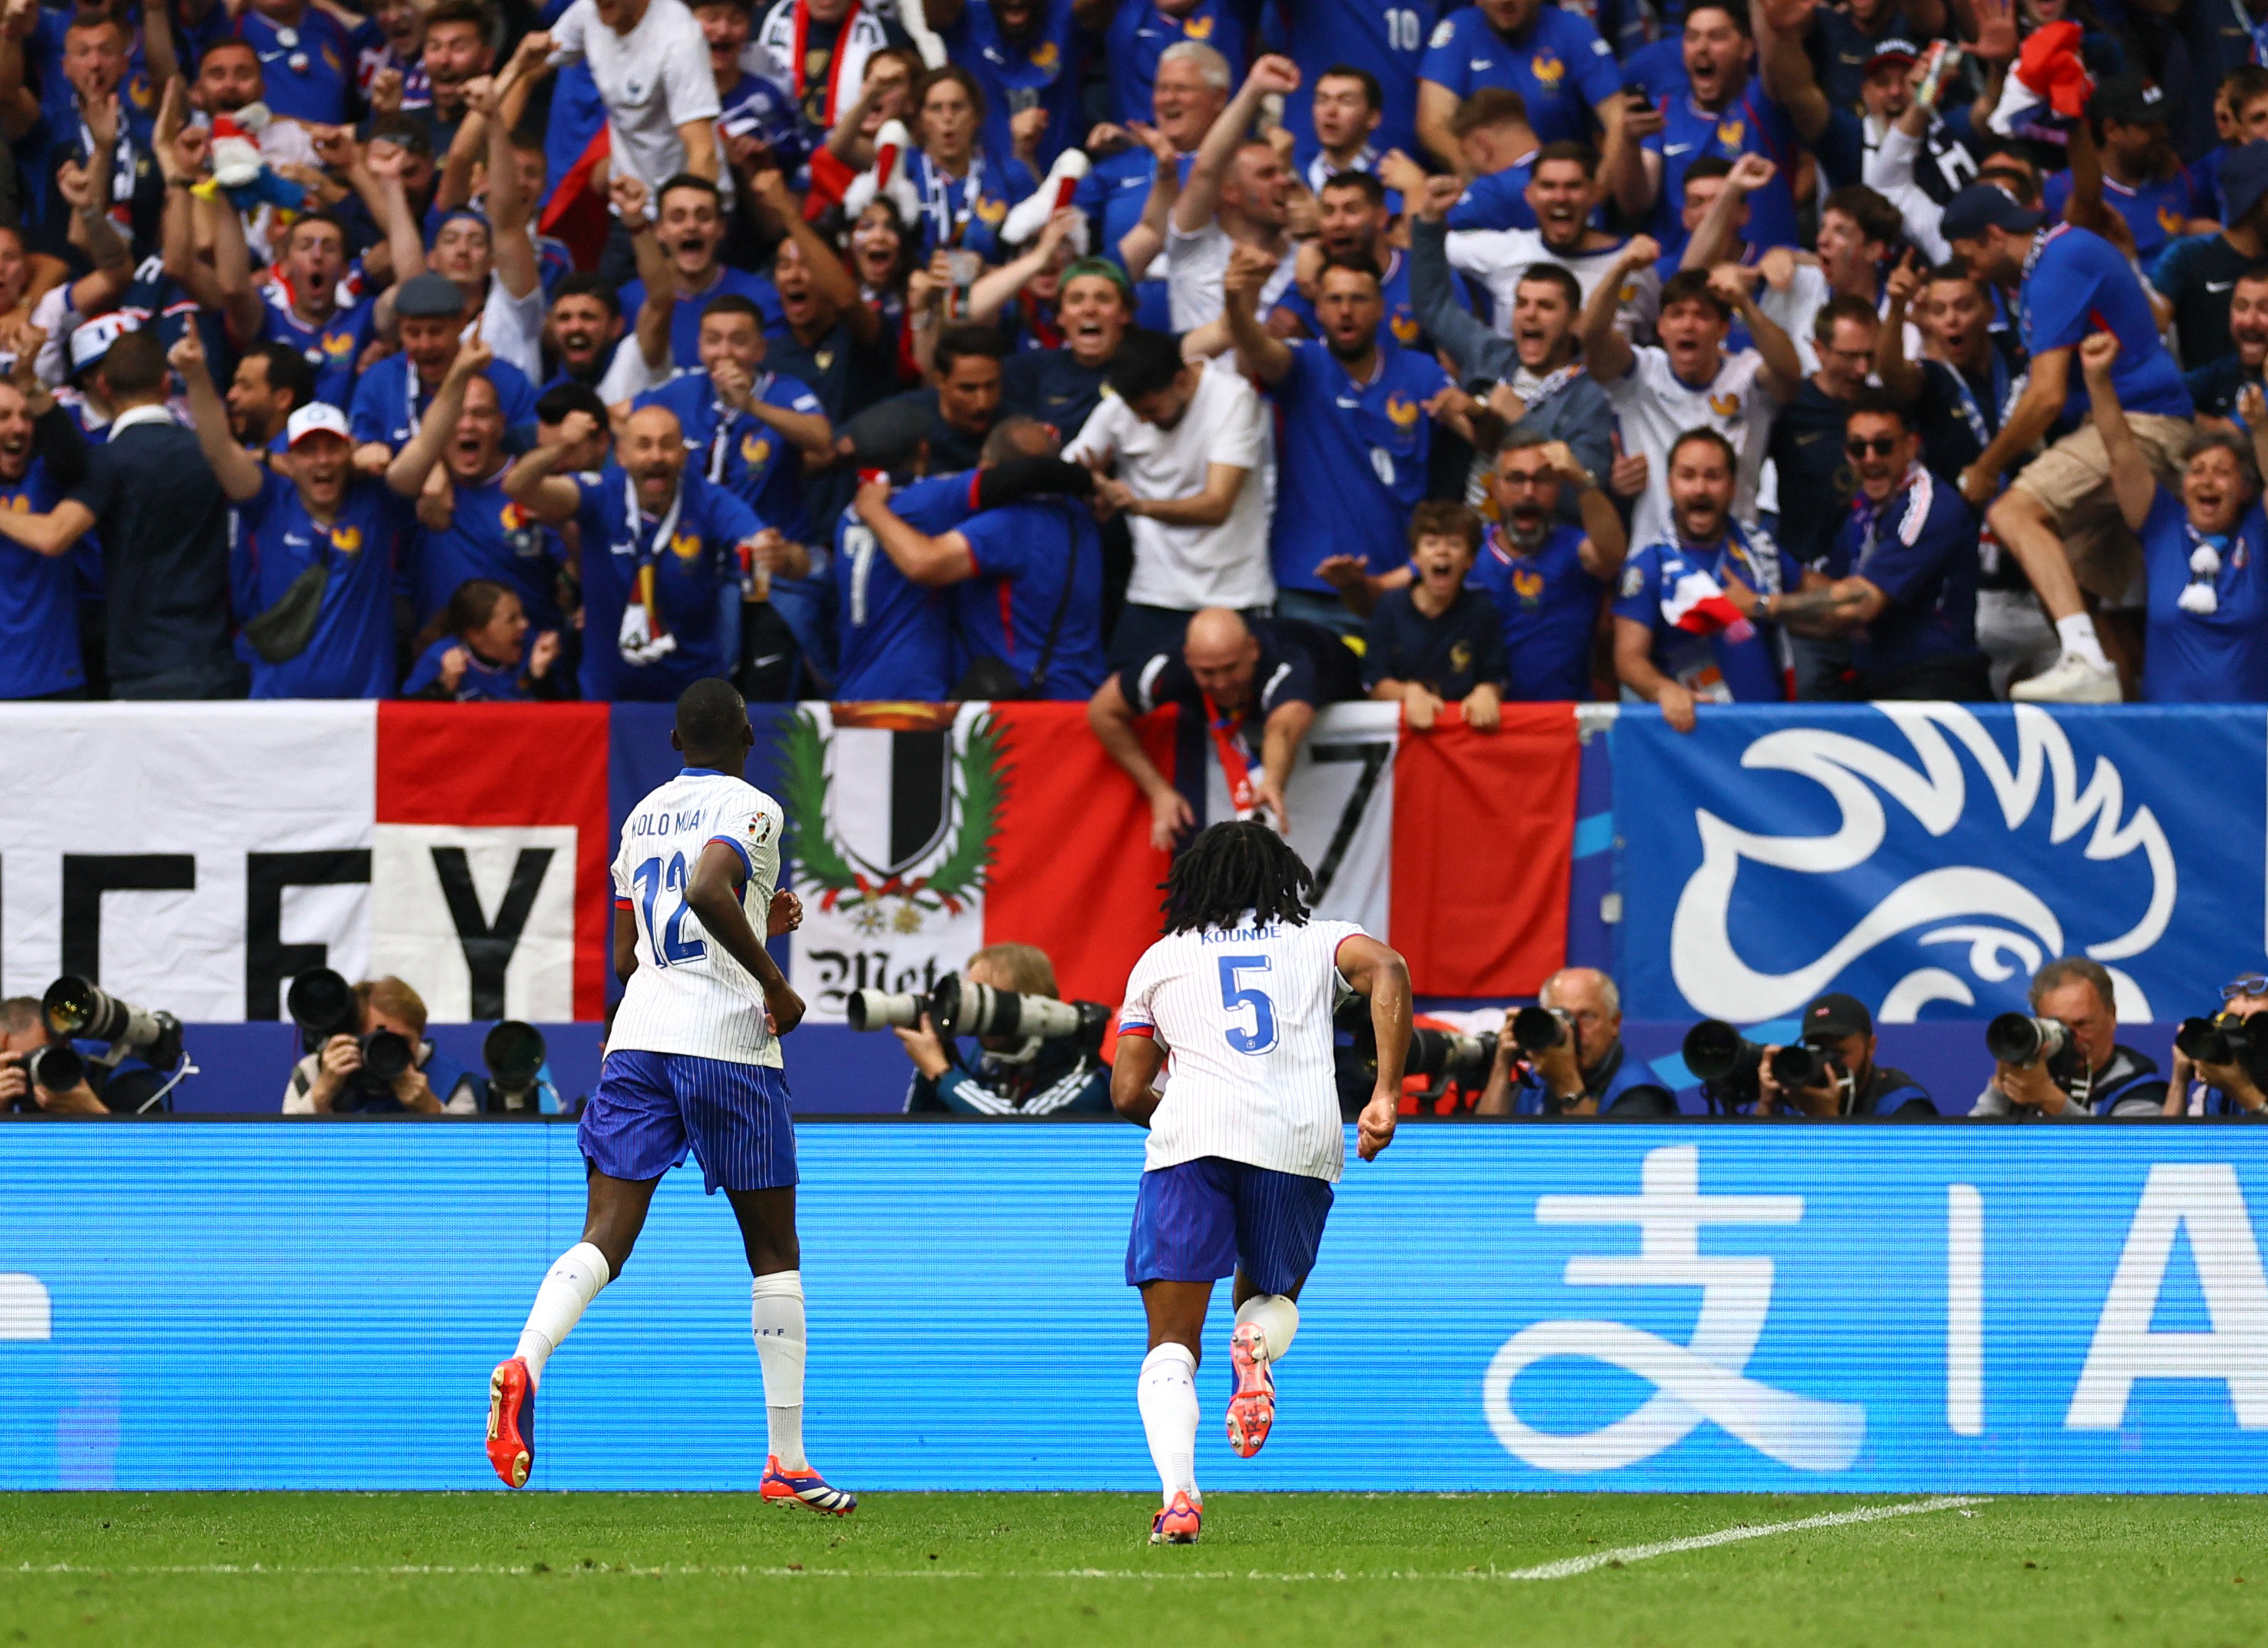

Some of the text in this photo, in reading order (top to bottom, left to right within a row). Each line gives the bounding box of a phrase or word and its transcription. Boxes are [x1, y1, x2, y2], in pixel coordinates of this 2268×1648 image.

[1384, 8, 1420, 51] 10
[843, 525, 875, 625] 7
[631, 813, 670, 840] KOLO
[633, 850, 707, 968] 12
[1202, 925, 1282, 945] KOUNDE
[806, 949, 937, 1014] Met
[1218, 955, 1279, 1056] 5
